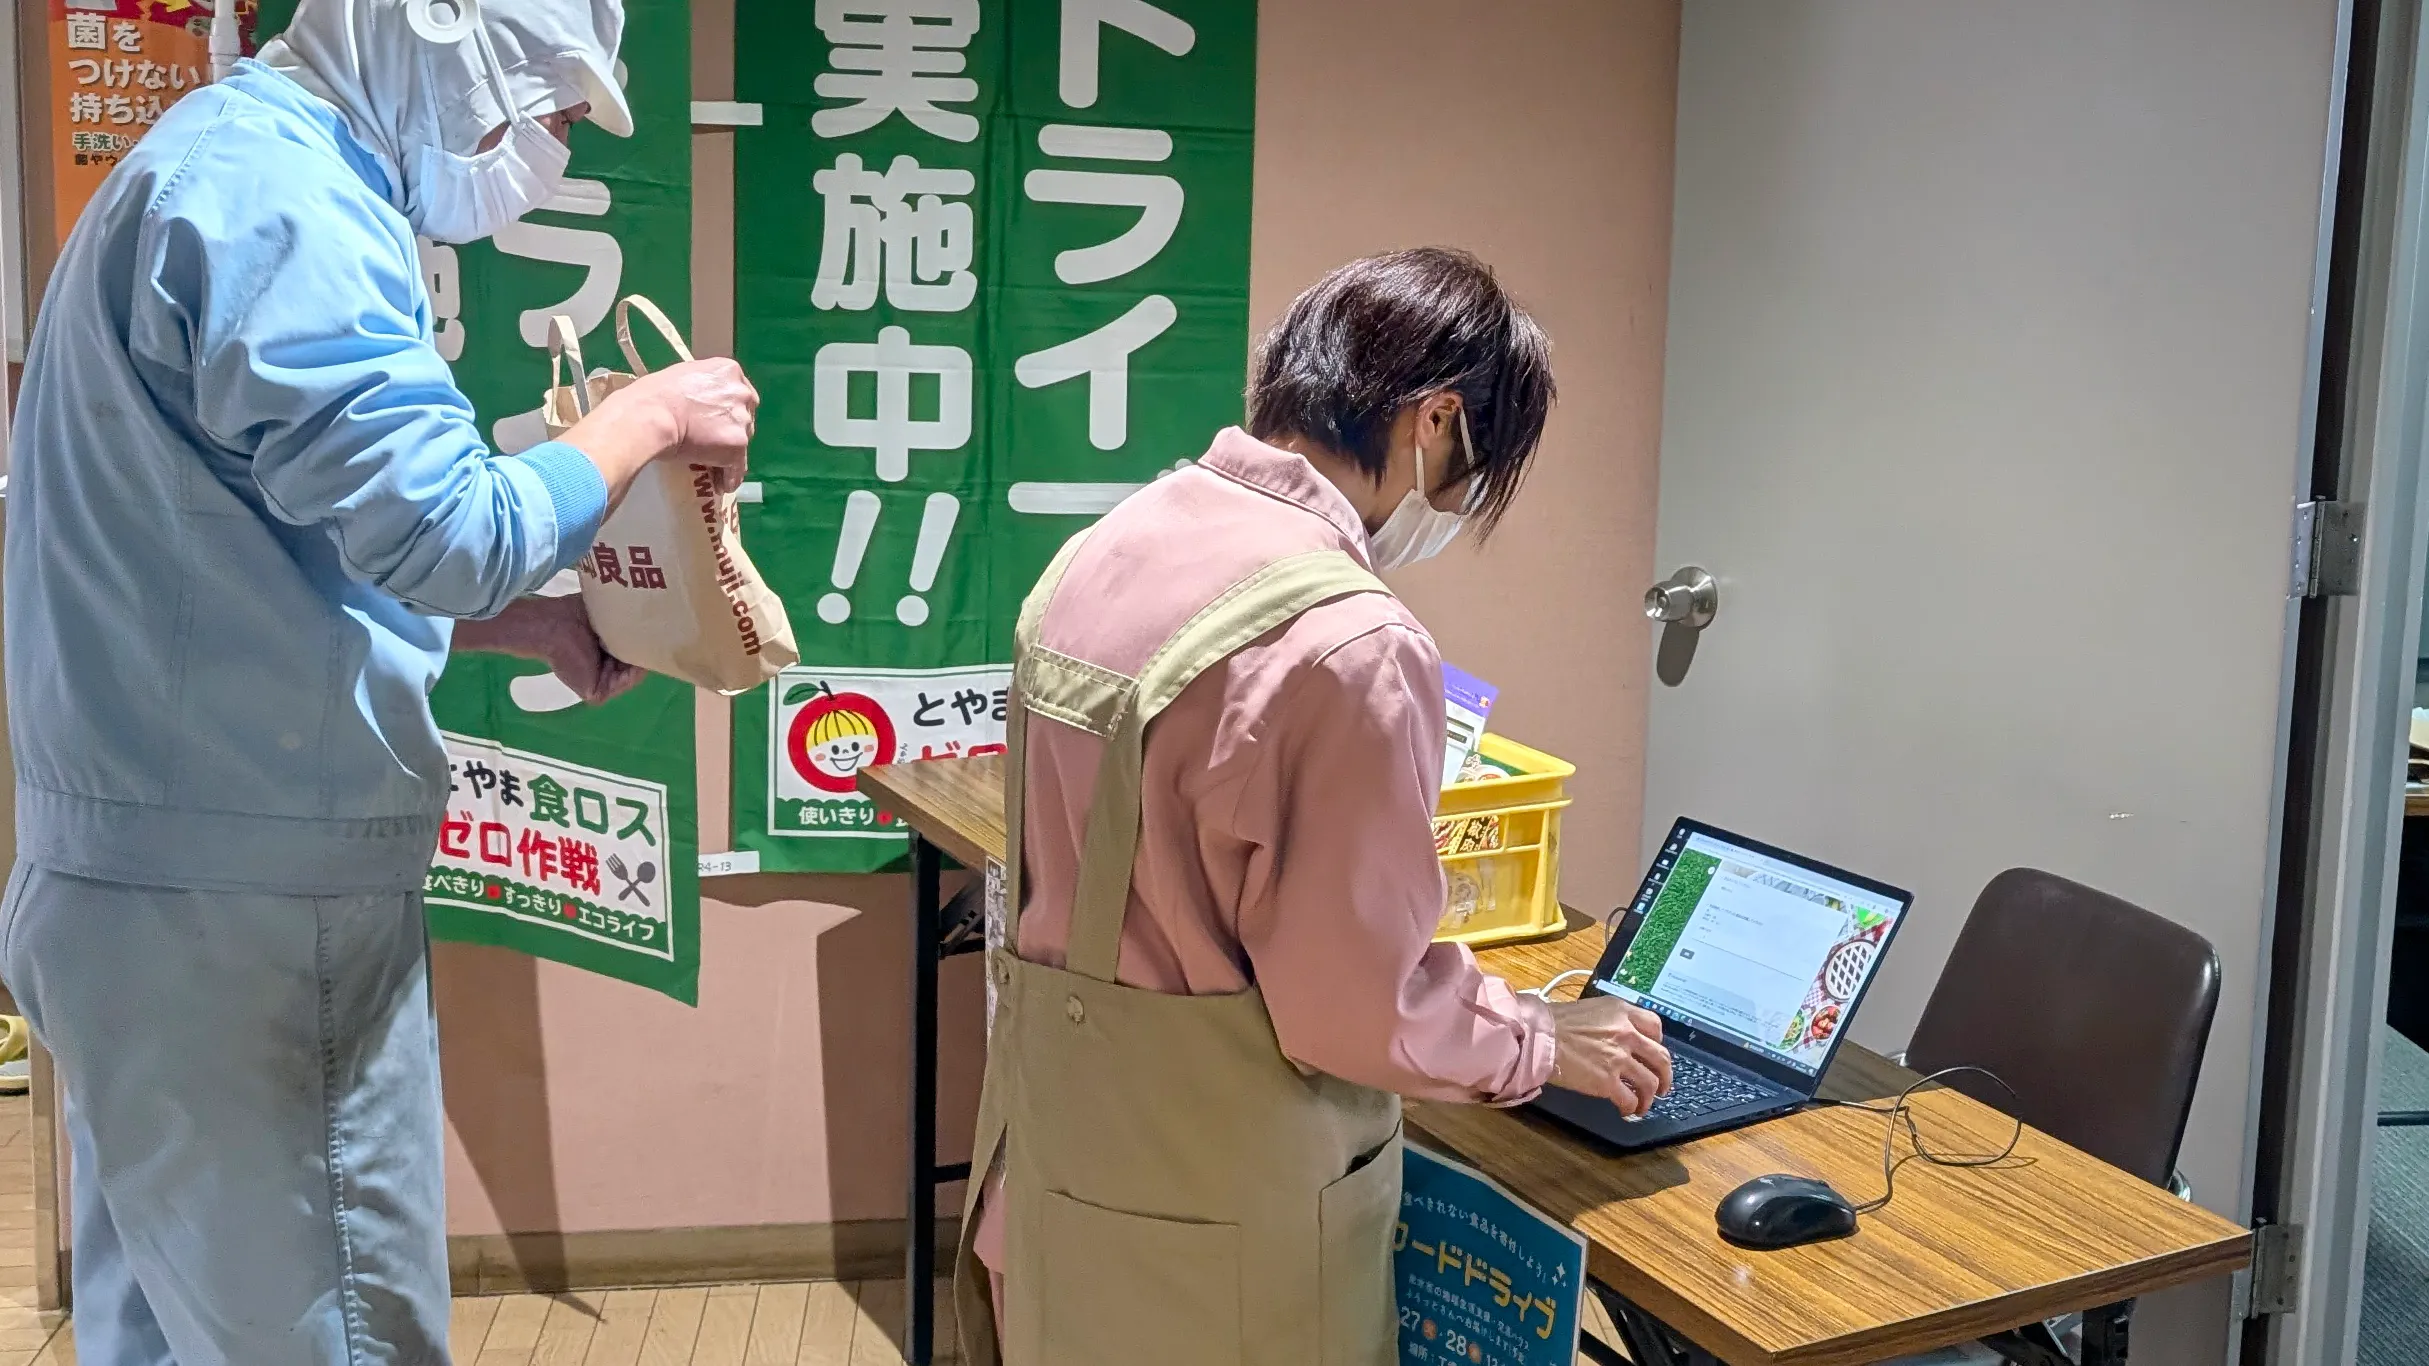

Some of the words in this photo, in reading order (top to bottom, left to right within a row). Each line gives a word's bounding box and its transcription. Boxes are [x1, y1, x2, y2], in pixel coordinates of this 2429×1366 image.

[66, 12, 142, 53] 菌を
[68, 58, 200, 90] つけない
[799, 805, 875, 826] 使いきり
[438, 810, 601, 896] ゼロ作戦
[503, 885, 562, 916] すっきり
[578, 904, 655, 941] エコライフ
[1400, 1305, 1421, 1332] 27
[1446, 1329, 1467, 1356] 28
